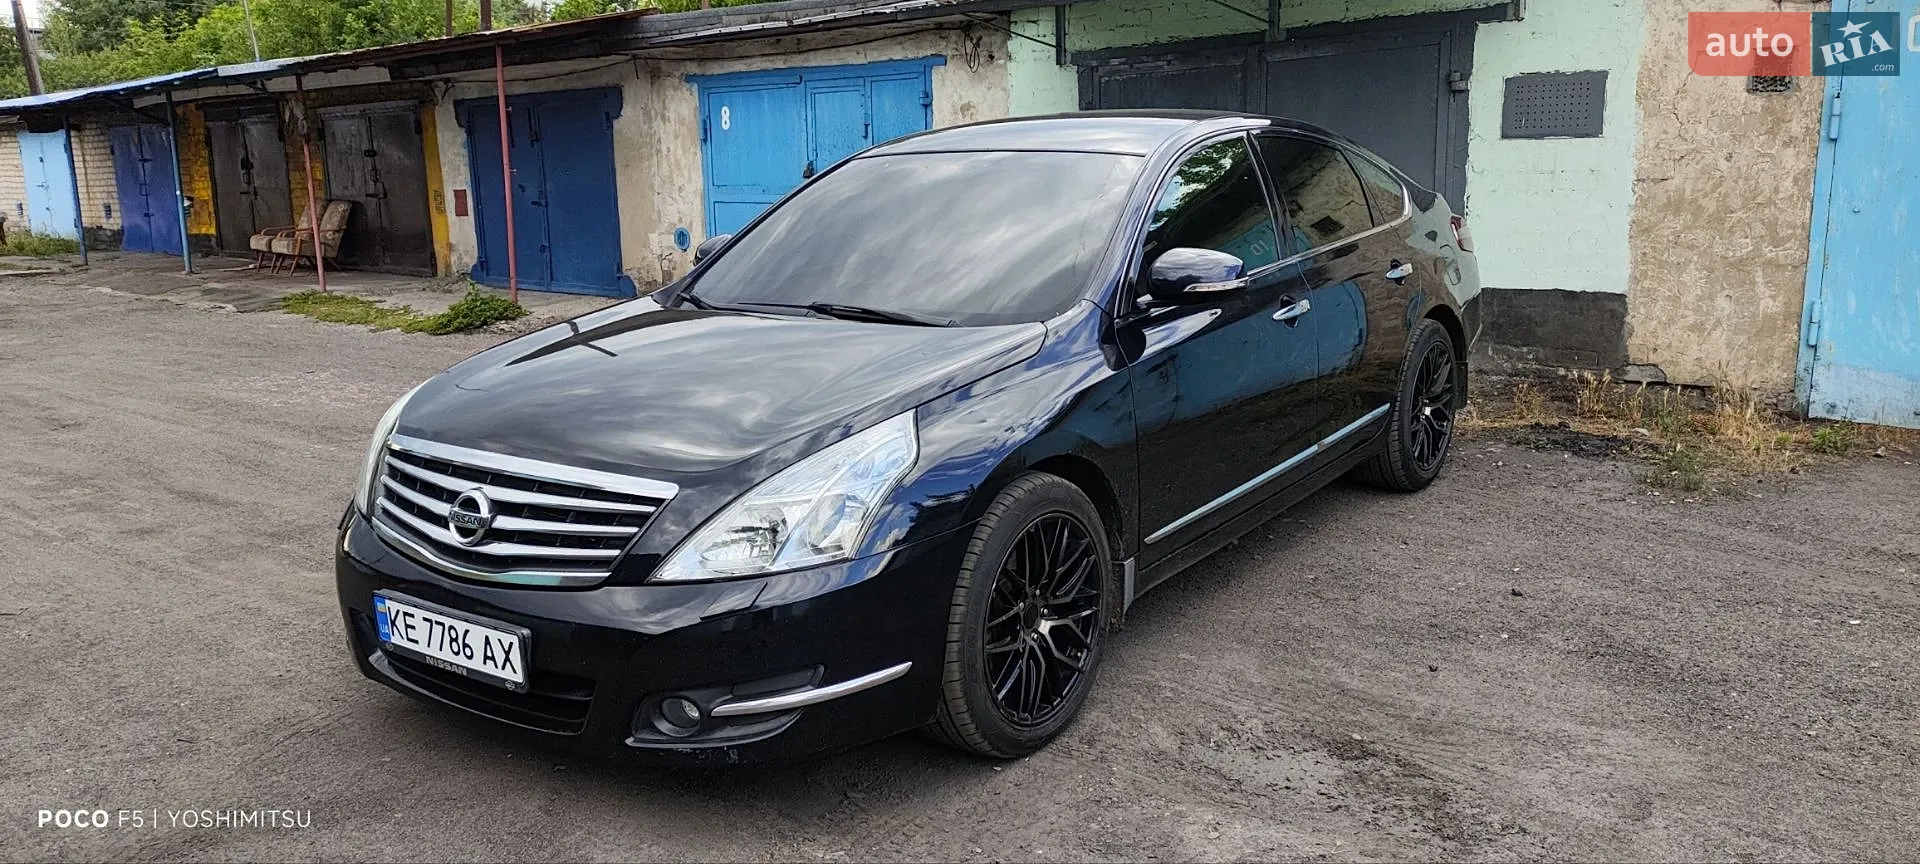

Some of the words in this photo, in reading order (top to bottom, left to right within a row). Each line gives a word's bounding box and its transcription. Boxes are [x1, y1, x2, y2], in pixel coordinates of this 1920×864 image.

[721, 106, 730, 130] 8
[380, 623, 389, 633] UA
[388, 606, 419, 645] KE
[422, 617, 474, 660] 7786
[483, 634, 517, 675] AX
[425, 656, 467, 676] NISSAN
